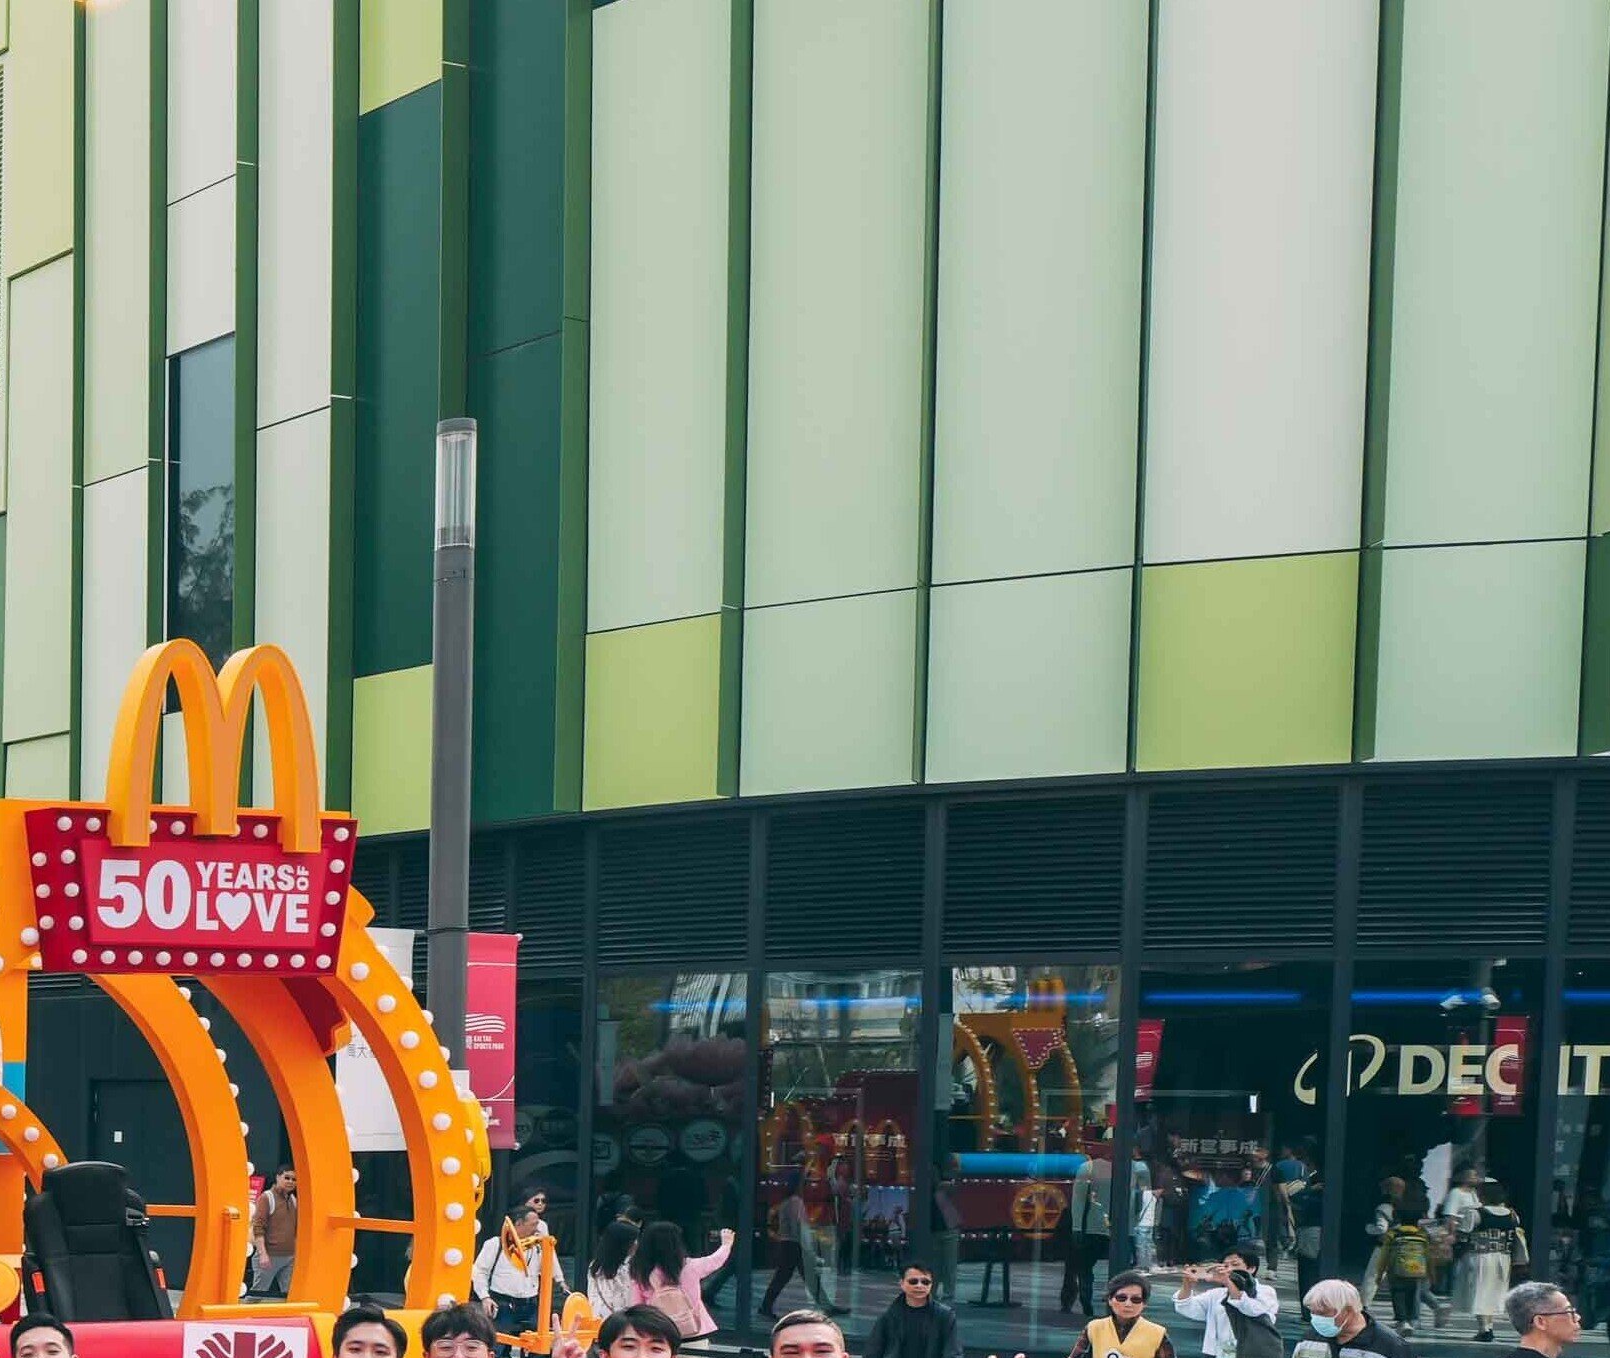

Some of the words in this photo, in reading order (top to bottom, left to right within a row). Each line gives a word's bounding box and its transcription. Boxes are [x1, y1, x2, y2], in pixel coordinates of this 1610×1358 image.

[97, 859, 192, 930] 50
[196, 861, 295, 891] YEARS
[295, 865, 310, 891] OF
